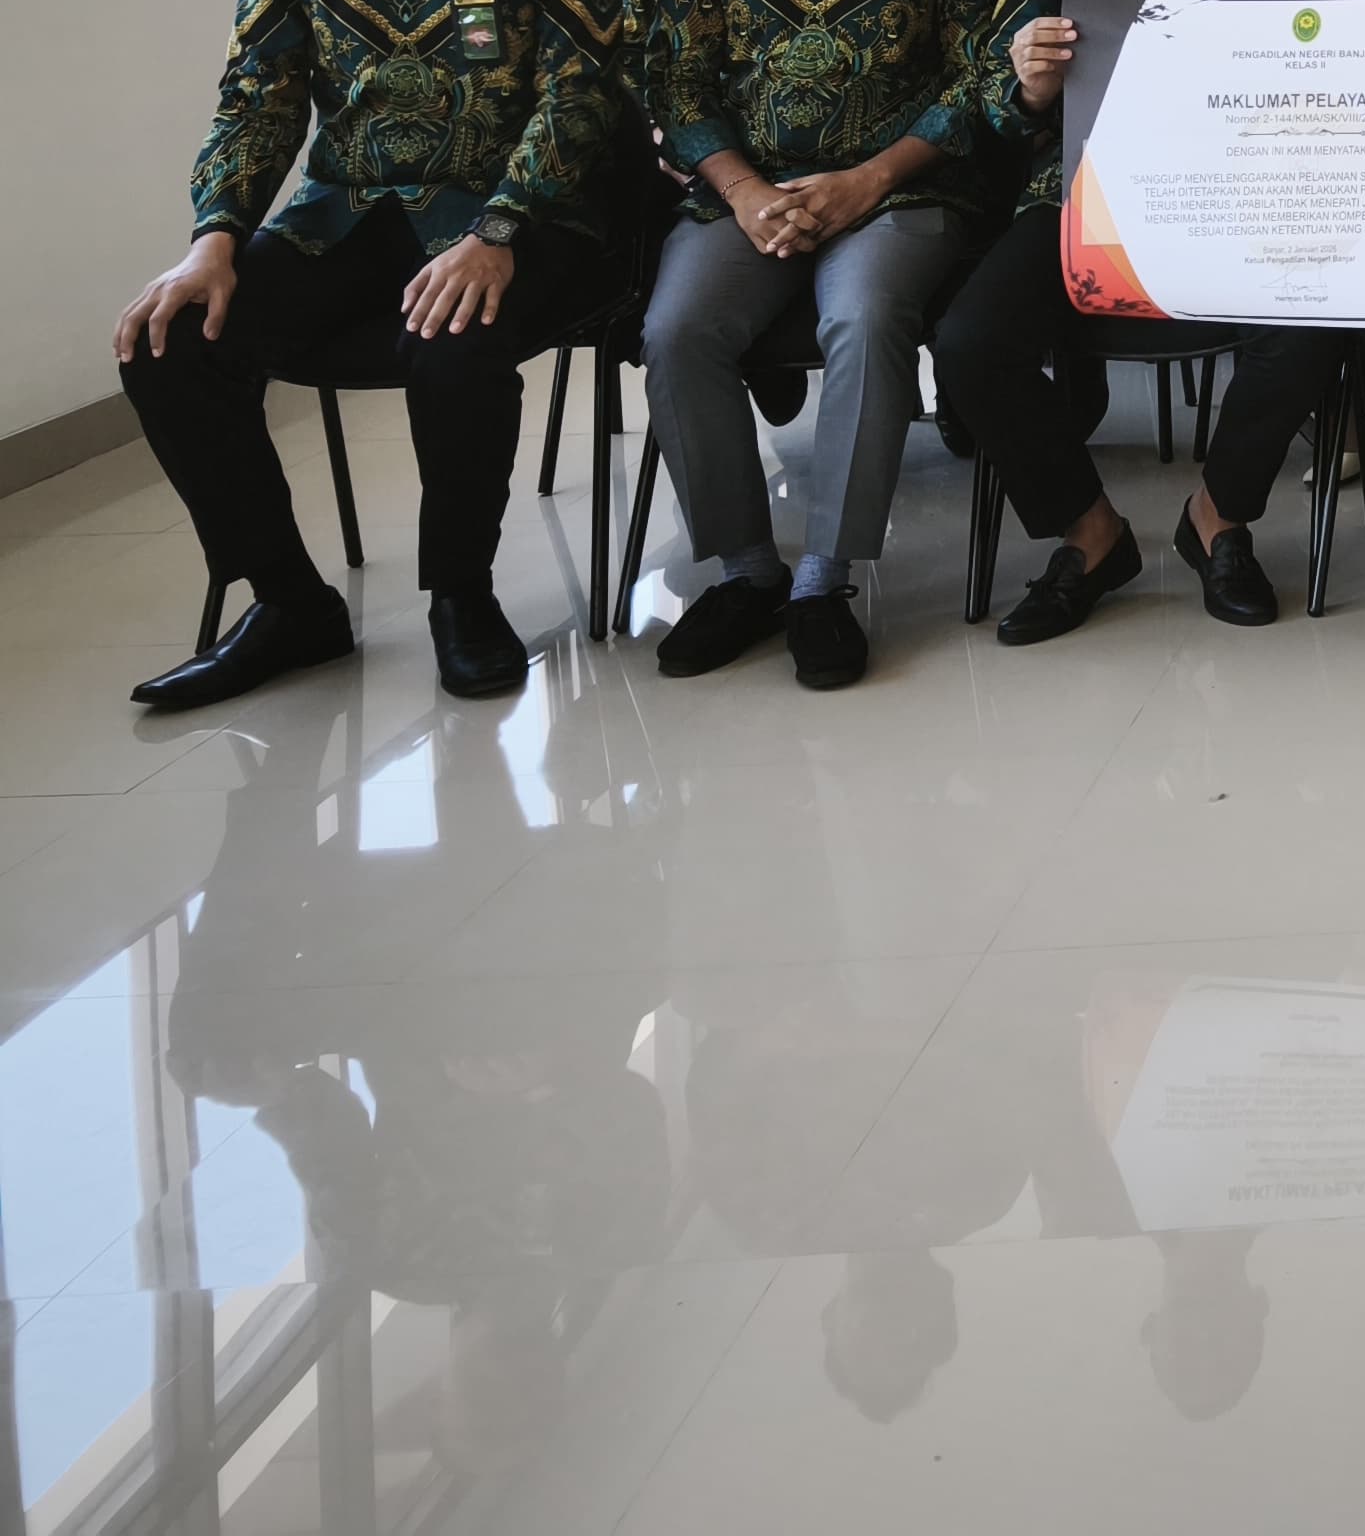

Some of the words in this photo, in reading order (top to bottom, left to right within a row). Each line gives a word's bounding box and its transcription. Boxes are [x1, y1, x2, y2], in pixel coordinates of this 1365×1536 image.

[1231, 50, 1296, 59] PENGADILAN
[1298, 49, 1336, 59] NEGERI
[1284, 60, 1317, 70] KELAS
[1320, 60, 1326, 69] II
[1207, 93, 1300, 109] MAKLUMAT
[1224, 145, 1269, 157] DENGAN
[1271, 145, 1284, 157] INI
[1284, 145, 1311, 157] KAMI
[1183, 172, 1296, 184] MENYELENGGARAKAN
[1297, 171, 1358, 183] PELAYANAN
[1144, 187, 1176, 198] TELAH
[1177, 186, 1240, 197] DITETAPKAN
[1242, 186, 1264, 197] DAN
[1264, 185, 1293, 196] AKAN
[1294, 185, 1358, 196] MELAKUKAN
[1144, 213, 1197, 225] MENERIMA
[1199, 213, 1237, 224] SANKSI
[1237, 212, 1260, 223] DAN
[1260, 211, 1330, 223] MEMBERIKAN
